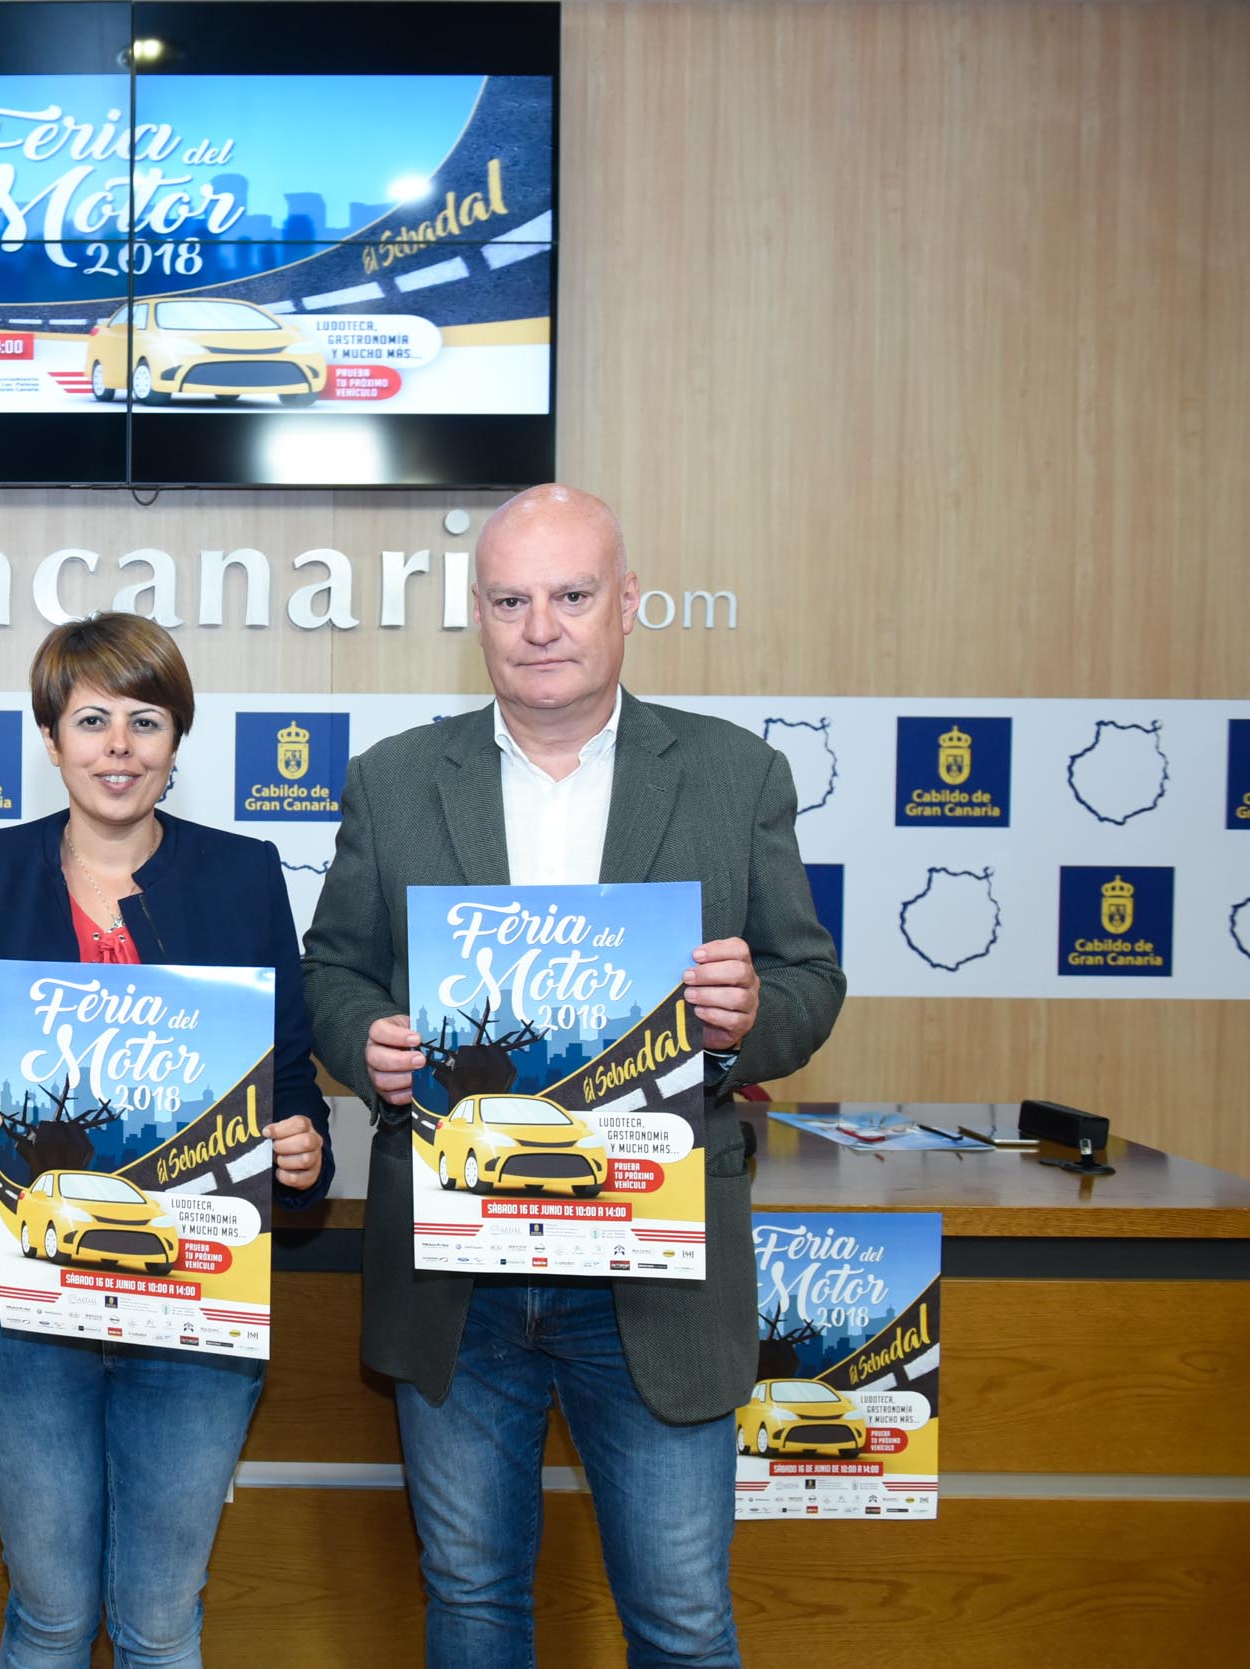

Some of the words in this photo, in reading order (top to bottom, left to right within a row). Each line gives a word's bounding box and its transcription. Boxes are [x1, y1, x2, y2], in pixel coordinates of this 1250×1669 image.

[183, 138, 235, 165] del
[380, 158, 508, 267] Sebadal
[83, 236, 203, 276] 2018
[332, 349, 338, 358] Y
[342, 349, 382, 359] MUCHO
[251, 784, 308, 797] Cabildo
[310, 784, 330, 797] de
[912, 789, 969, 803] Cabildo
[972, 789, 992, 803] de
[245, 798, 280, 811] Gran
[283, 798, 339, 811] Canaria
[905, 803, 942, 816] Gran
[944, 803, 1001, 817] Canaria
[447, 901, 592, 960] Feria
[592, 927, 625, 948] del
[1075, 939, 1132, 952] Cabildo
[1134, 939, 1154, 952] de
[1068, 952, 1104, 965] Gran
[1107, 953, 1163, 966] Canaria
[438, 947, 632, 1024] Motor
[29, 977, 168, 1035] Feria
[168, 1009, 200, 1030] del
[537, 1003, 607, 1031] 2018
[595, 999, 692, 1097] Sebadal
[20, 1023, 206, 1104] Motor
[113, 1084, 181, 1113] 2018
[599, 1117, 645, 1129] LUDOTECA,
[168, 1084, 262, 1179] Sebadal
[607, 1129, 669, 1141] GASTRONOMÍA
[610, 1143, 616, 1153] Y
[618, 1143, 649, 1153] MUCHO
[614, 1162, 640, 1171] PRUEBA
[614, 1171, 623, 1180] TU
[624, 1171, 654, 1180] PRÓXIMO
[614, 1180, 646, 1189] VEHÍCULO
[171, 1198, 215, 1212] LUDOTECA,
[487, 1202, 518, 1214] SÁBADO
[519, 1204, 528, 1214] 16
[529, 1204, 540, 1215] DE
[541, 1205, 563, 1215] JUNIO
[564, 1205, 574, 1216] DE
[575, 1206, 597, 1217] 10:00
[598, 1207, 604, 1217] A
[605, 1207, 627, 1218] 14:00
[179, 1211, 237, 1225] GASTRONOMÍA
[182, 1224, 186, 1233] Y
[190, 1225, 218, 1236] MUCHO
[185, 1243, 210, 1252] PRUEBA
[752, 1225, 860, 1271] Feria
[859, 1246, 885, 1263] del
[185, 1251, 193, 1260] TU
[194, 1252, 222, 1262] PRÓXIMO
[185, 1260, 215, 1270] VEHÍCULO
[65, 1272, 94, 1286] SÁBADO
[95, 1277, 104, 1287] 16
[105, 1278, 114, 1288] DE
[115, 1279, 136, 1290] JUNIO
[137, 1281, 147, 1292] DE
[148, 1283, 168, 1294] 10:00
[169, 1284, 175, 1294] A
[175, 1285, 196, 1297] 14:00
[757, 1261, 889, 1323] Motor
[816, 1307, 870, 1328] 2018
[858, 1303, 931, 1379] Sebadal
